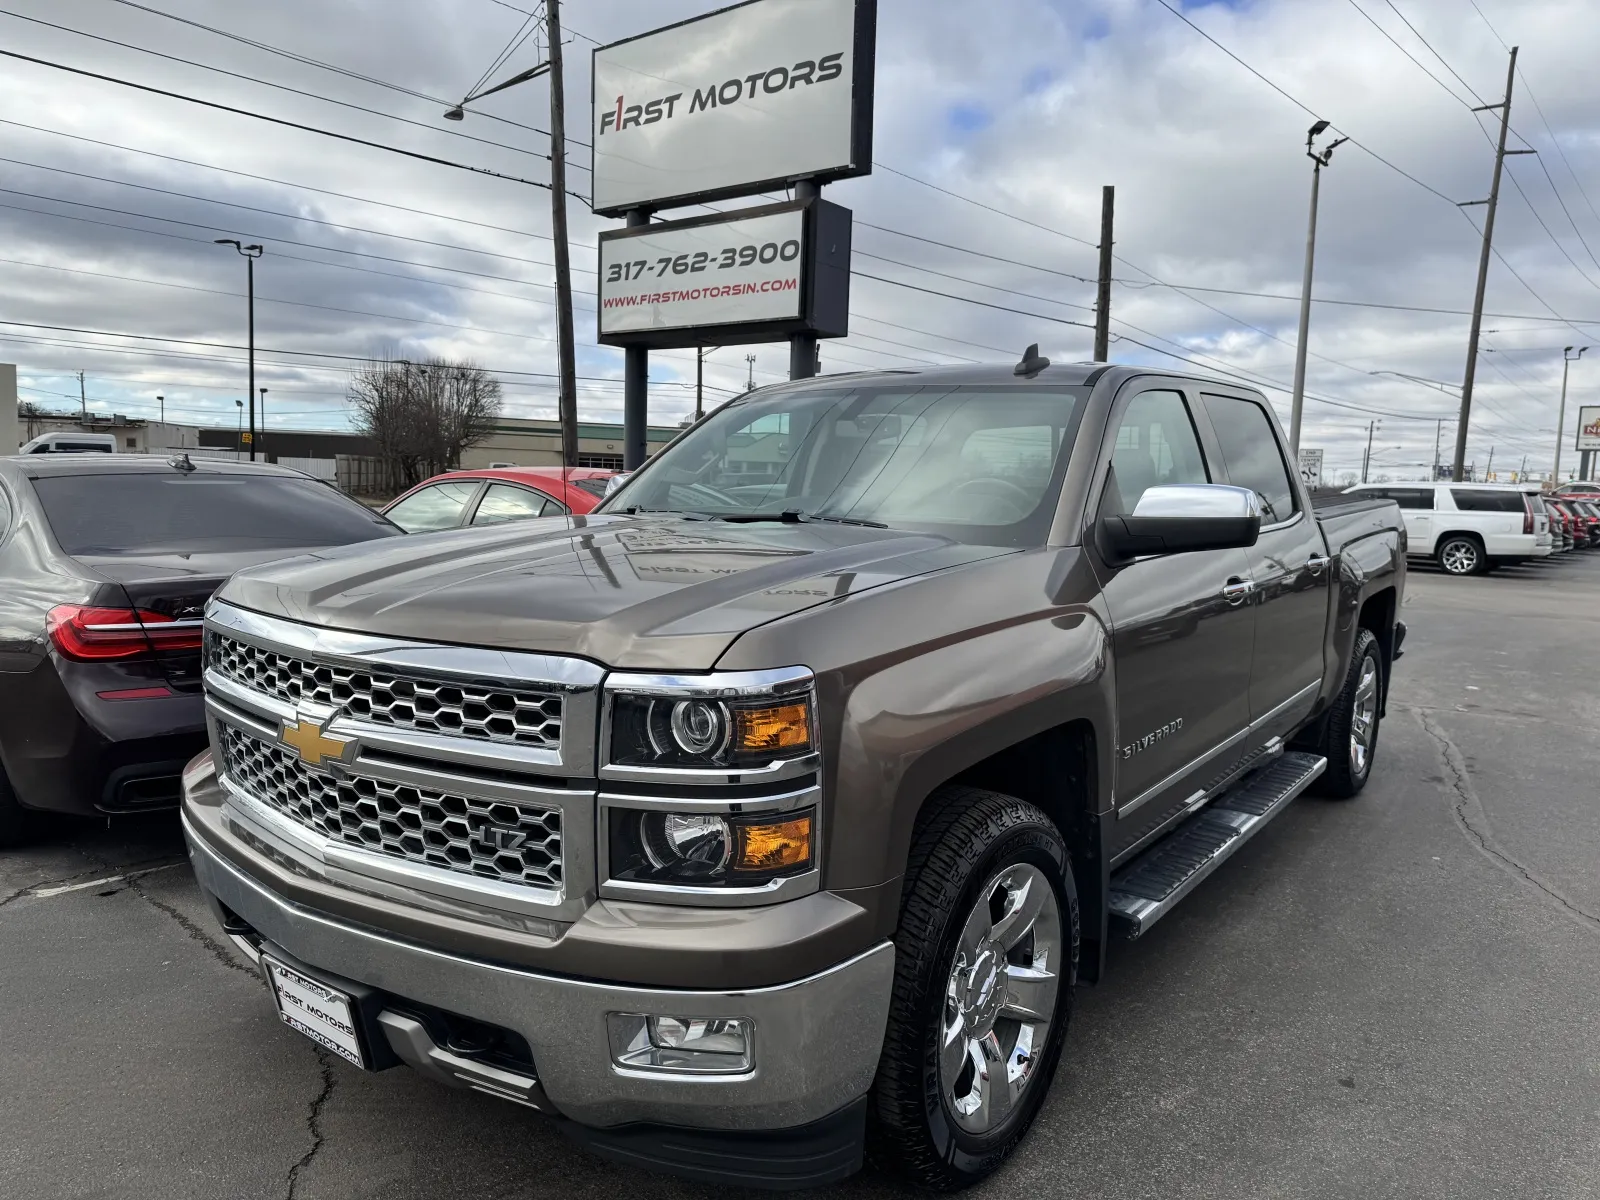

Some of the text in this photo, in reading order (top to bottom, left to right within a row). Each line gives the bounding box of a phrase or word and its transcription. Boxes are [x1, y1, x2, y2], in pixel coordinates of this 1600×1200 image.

[689, 52, 844, 114] MOTORS
[606, 240, 799, 283] 317-762-3900
[603, 278, 796, 308] WWW.FIRSTMOTORSIN.COM
[1122, 717, 1183, 760] SILVERADO
[480, 825, 527, 853] LTZ
[306, 1003, 353, 1036] MOTORS
